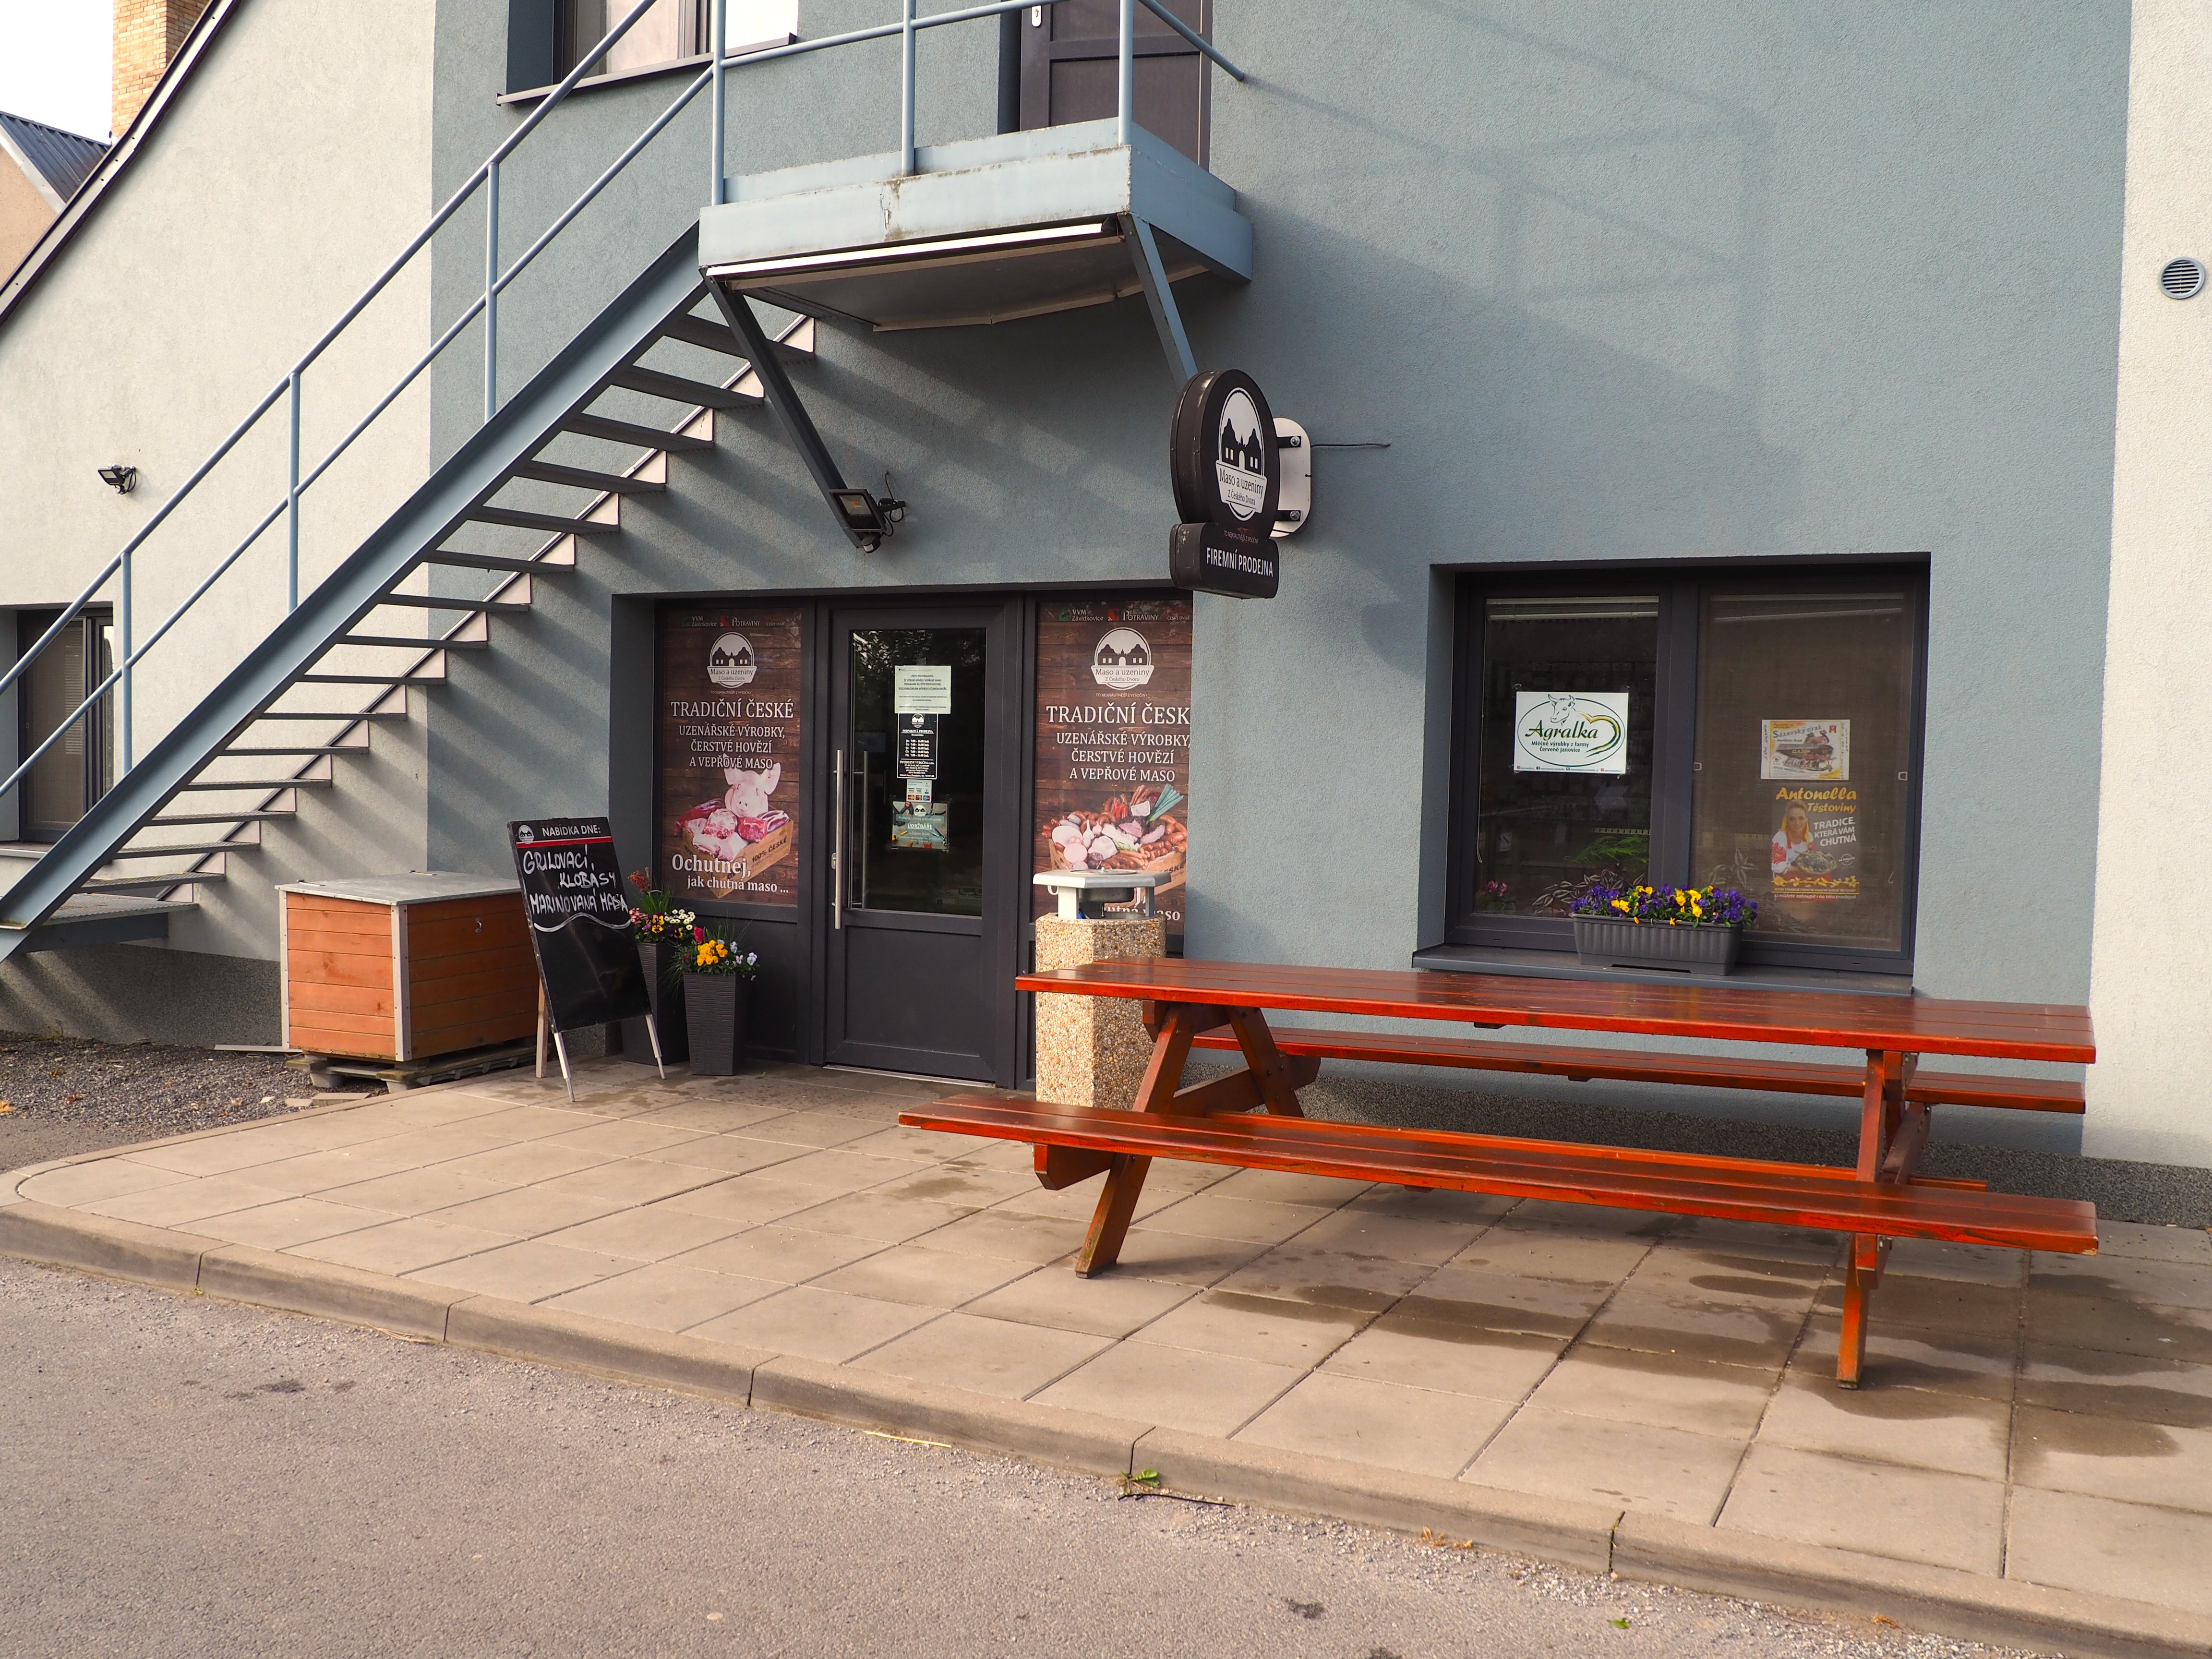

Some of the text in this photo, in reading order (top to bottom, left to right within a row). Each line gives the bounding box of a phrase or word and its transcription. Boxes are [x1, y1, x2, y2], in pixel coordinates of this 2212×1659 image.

[1219, 468, 1264, 498] Maso a uzeniny
[1231, 490, 1245, 502] Českého
[1245, 495, 1256, 505] Dvora
[1206, 547, 1274, 578] FIREMNÍ PRODEJNA
[1121, 668, 1150, 677] uzeniny
[671, 698, 793, 718] TRADIČNÍ ČESKÉ
[1046, 702, 1190, 724] TRADIČNÍ ČESK
[679, 723, 785, 738] UZENÁŘSKÉ VÝROBKY,
[1525, 720, 1598, 741] Agralka
[1773, 726, 1806, 738] Sázavský
[691, 739, 772, 753] ČERSTVÉ HOVĚZÍ
[1057, 730, 1190, 748] UZENÁŘSKÉ VÝROBKY,
[689, 755, 773, 769] A VEPŘOVÉ MASO
[1071, 748, 1174, 764] ČERSTVÉ HOVĚZÍ
[1069, 766, 1175, 782] A VEPŘOVÉ MASO
[1776, 787, 1857, 800] Antonella
[1807, 803, 1856, 814] Těstoviny
[542, 824, 601, 837] NABÍDKA DNE:
[1815, 826, 1855, 839] KTERÁ VÁM
[1820, 833, 1856, 847] CHUTNÁ
[523, 843, 588, 874] GRILOVACÍ
[672, 854, 751, 878] Ochutnej,
[687, 875, 705, 889] jak
[707, 877, 744, 890] chutná
[747, 882, 777, 892] maso
[529, 888, 598, 914] MARINOVANÁ
